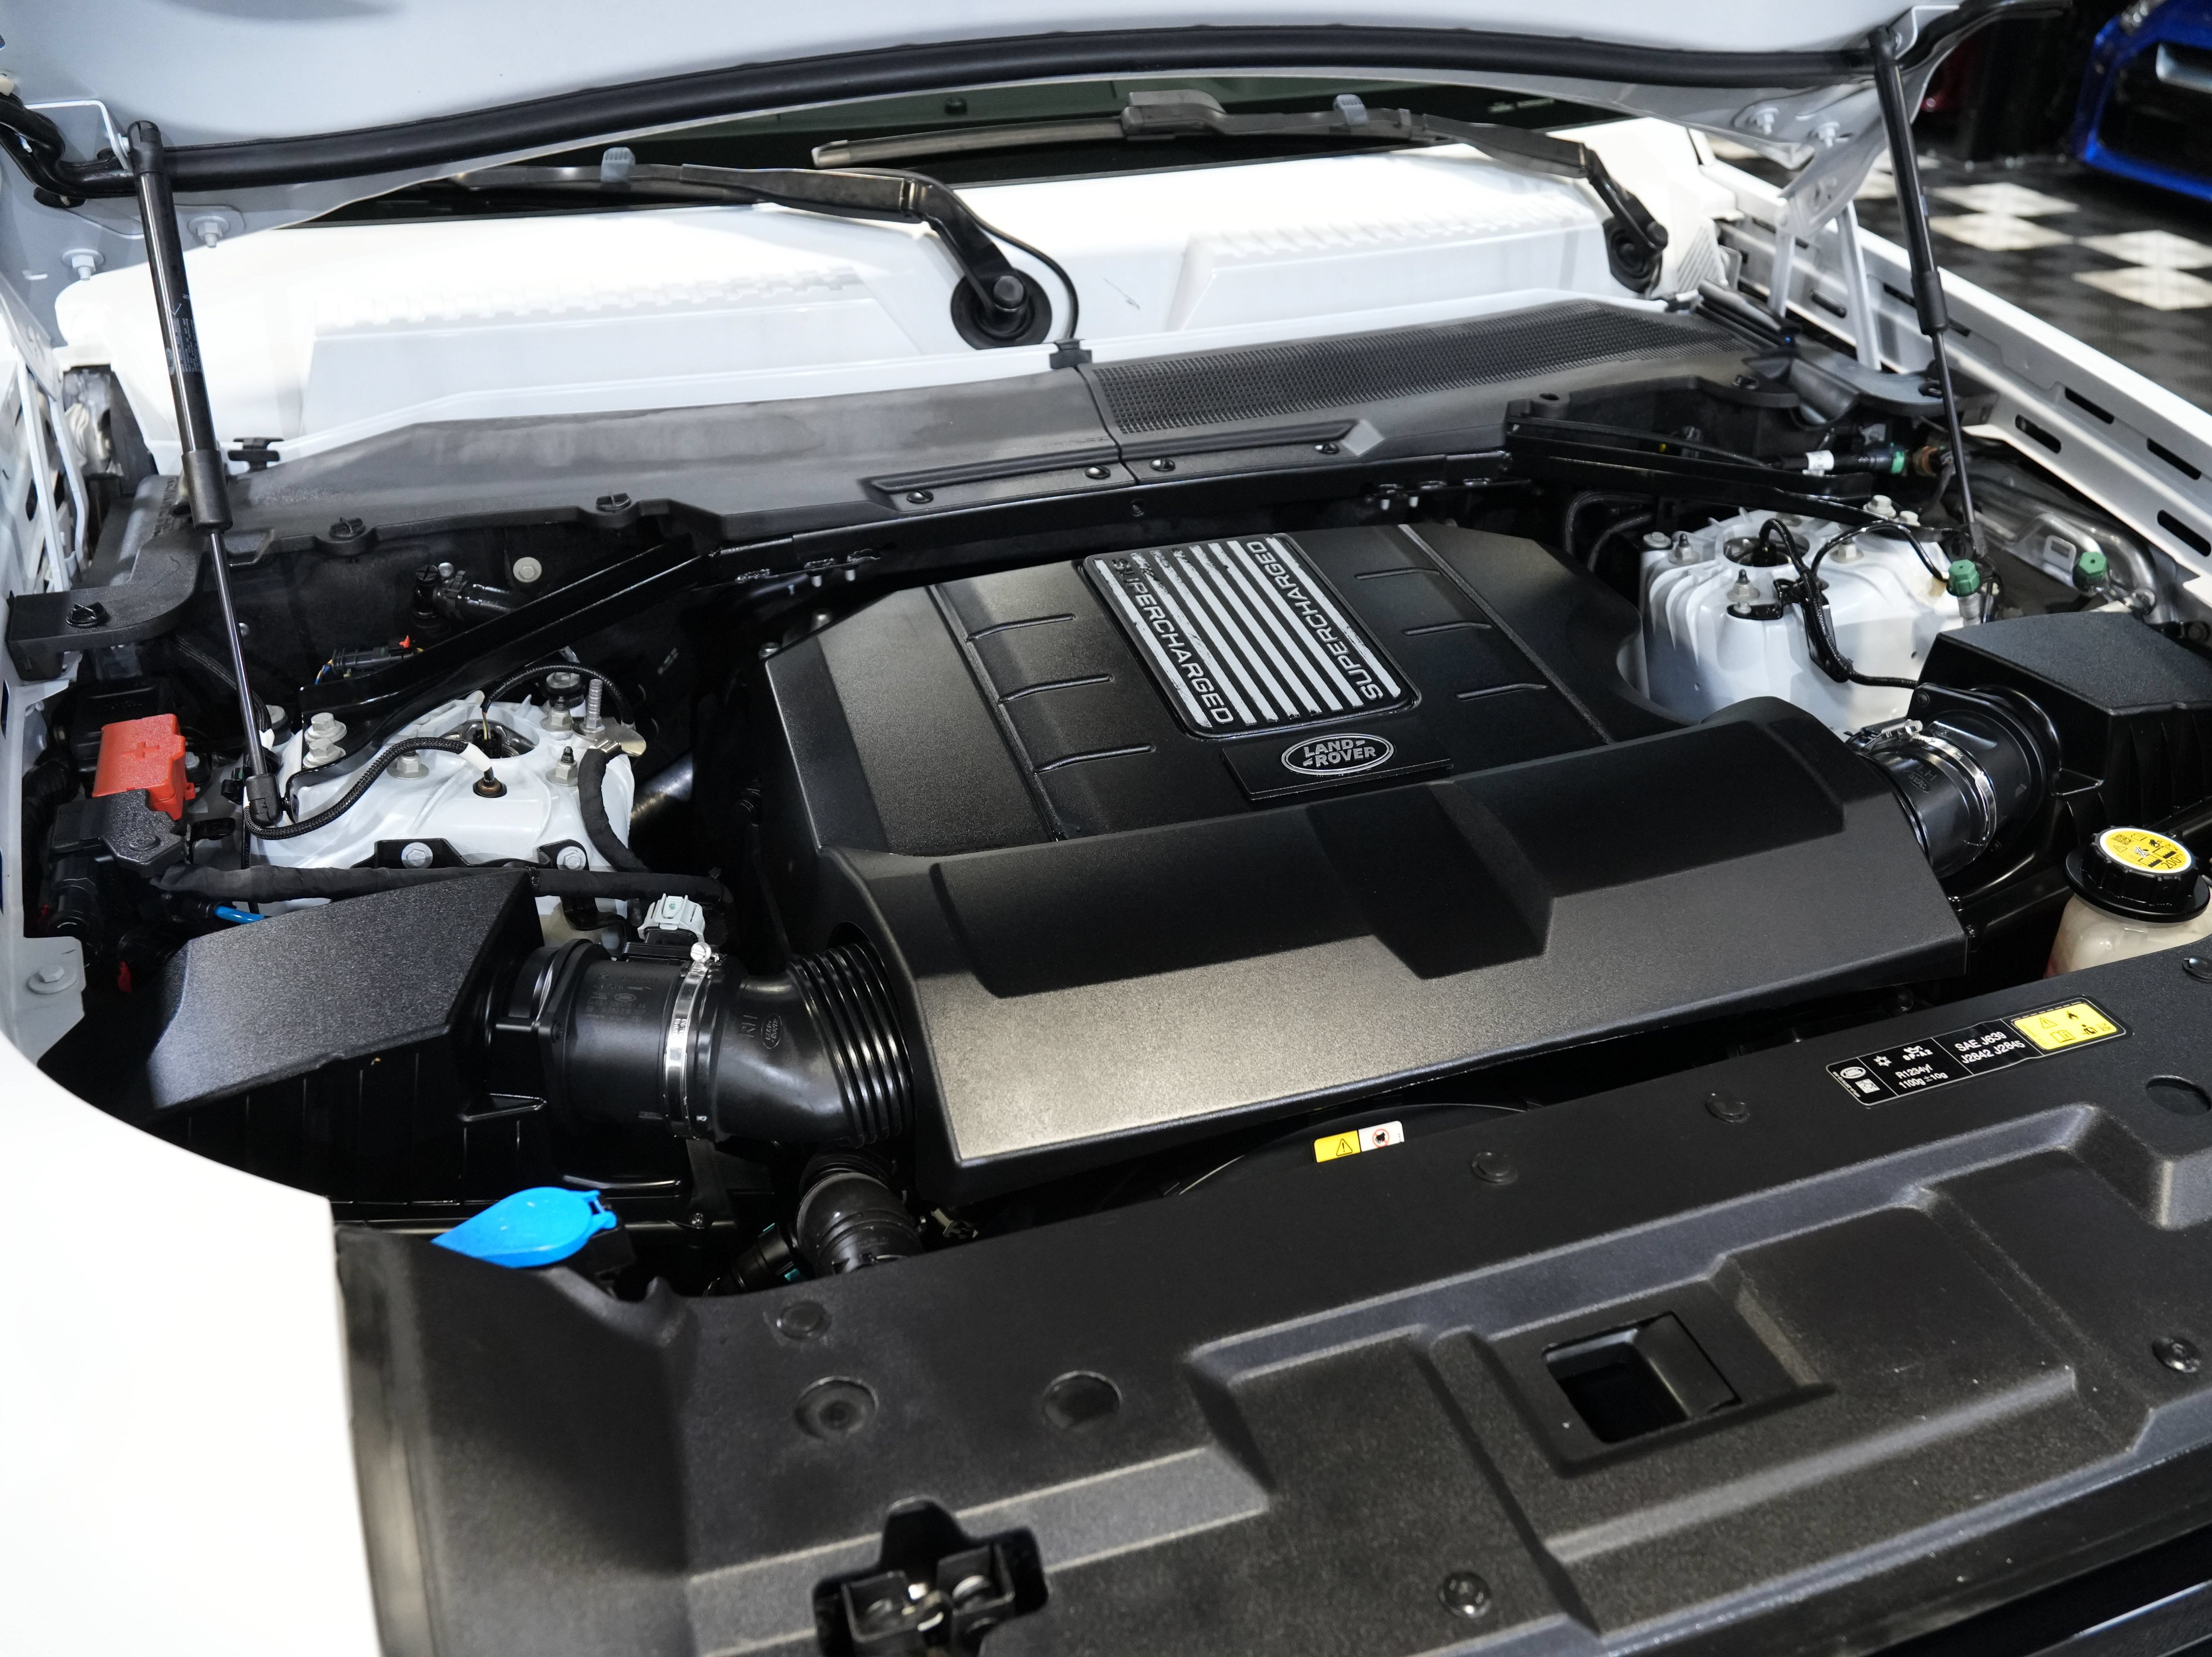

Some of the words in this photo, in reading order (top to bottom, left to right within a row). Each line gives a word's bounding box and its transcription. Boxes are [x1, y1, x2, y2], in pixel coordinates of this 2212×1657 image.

[1246, 541, 1383, 701] SUPERCHARGED
[1112, 558, 1234, 724] SUPERCHARGED
[1304, 739, 1354, 758] LAND
[1315, 746, 1377, 767] ROVER
[2161, 857, 2181, 869] 200
[1955, 1039, 1982, 1052] SAE
[1980, 1031, 2007, 1045] J639
[1961, 1049, 1994, 1064] J2842
[1993, 1040, 2026, 1054] J2845
[1895, 1063, 1934, 1079] R1234yf
[1899, 1078, 1926, 1089] 1100g
